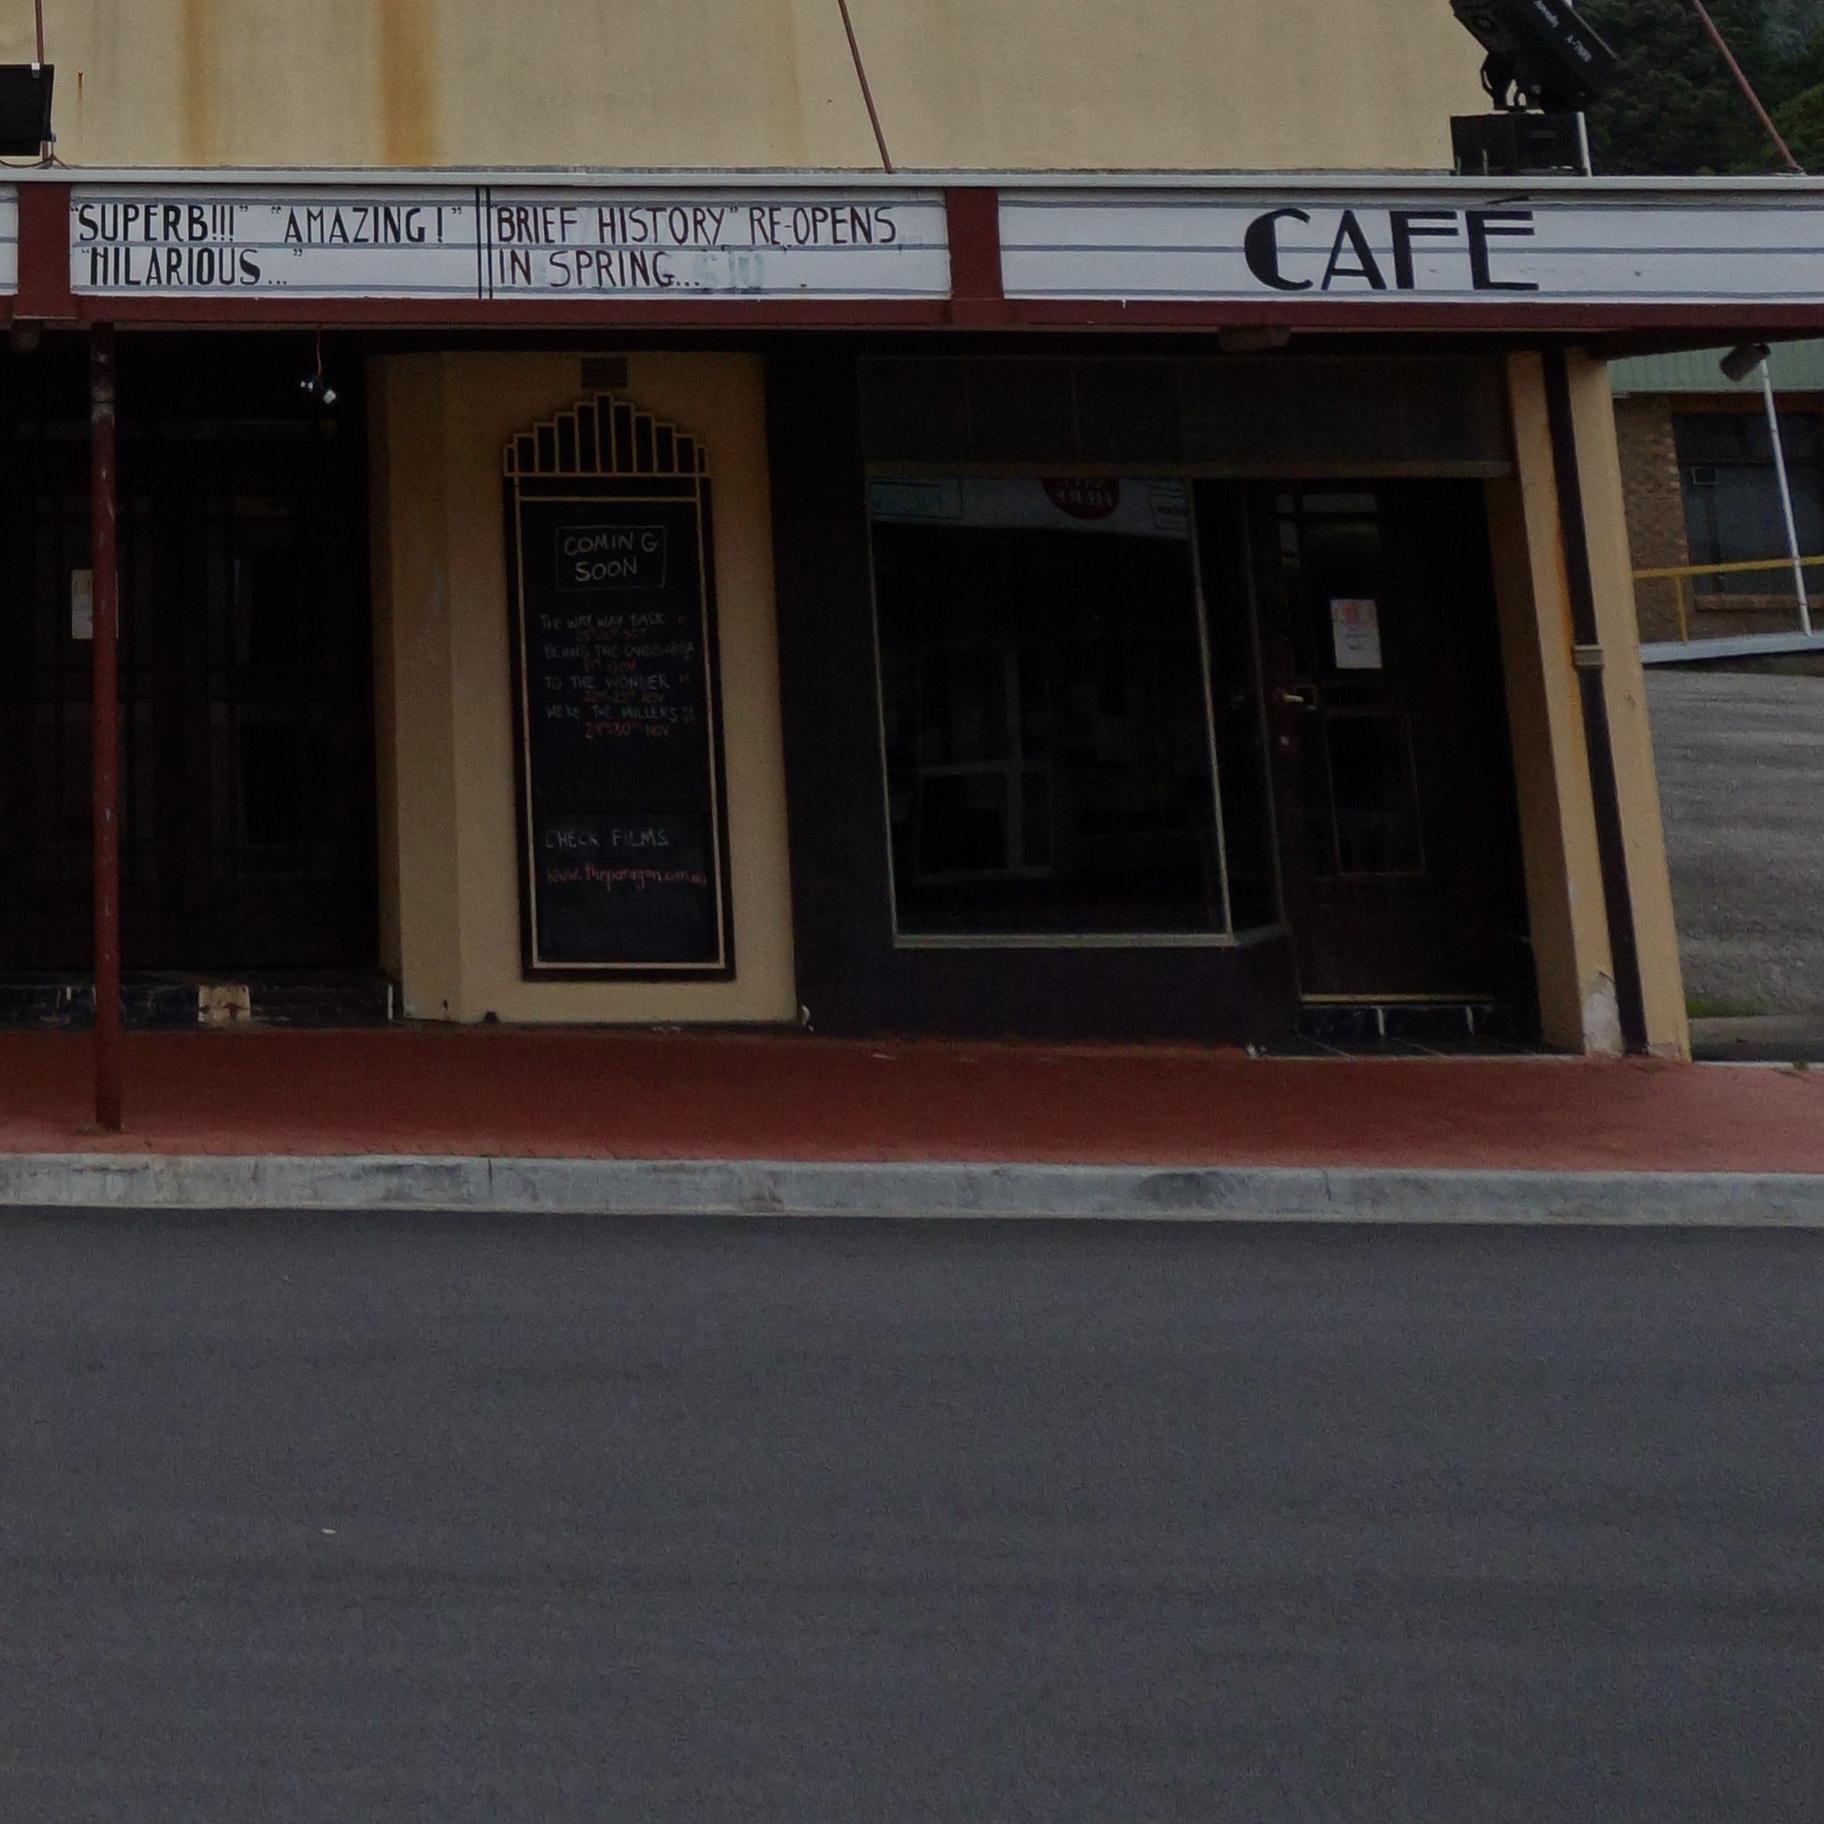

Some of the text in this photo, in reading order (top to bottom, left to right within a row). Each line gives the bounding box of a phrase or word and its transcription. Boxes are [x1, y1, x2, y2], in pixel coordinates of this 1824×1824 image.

[749, 207, 897, 246] RE-OPENS
[1244, 195, 1539, 291] CAFÉ
[497, 249, 533, 286] IN
[564, 531, 659, 557] COMING
[575, 555, 638, 582] SOON
[545, 828, 670, 848] CHECK FILMS
